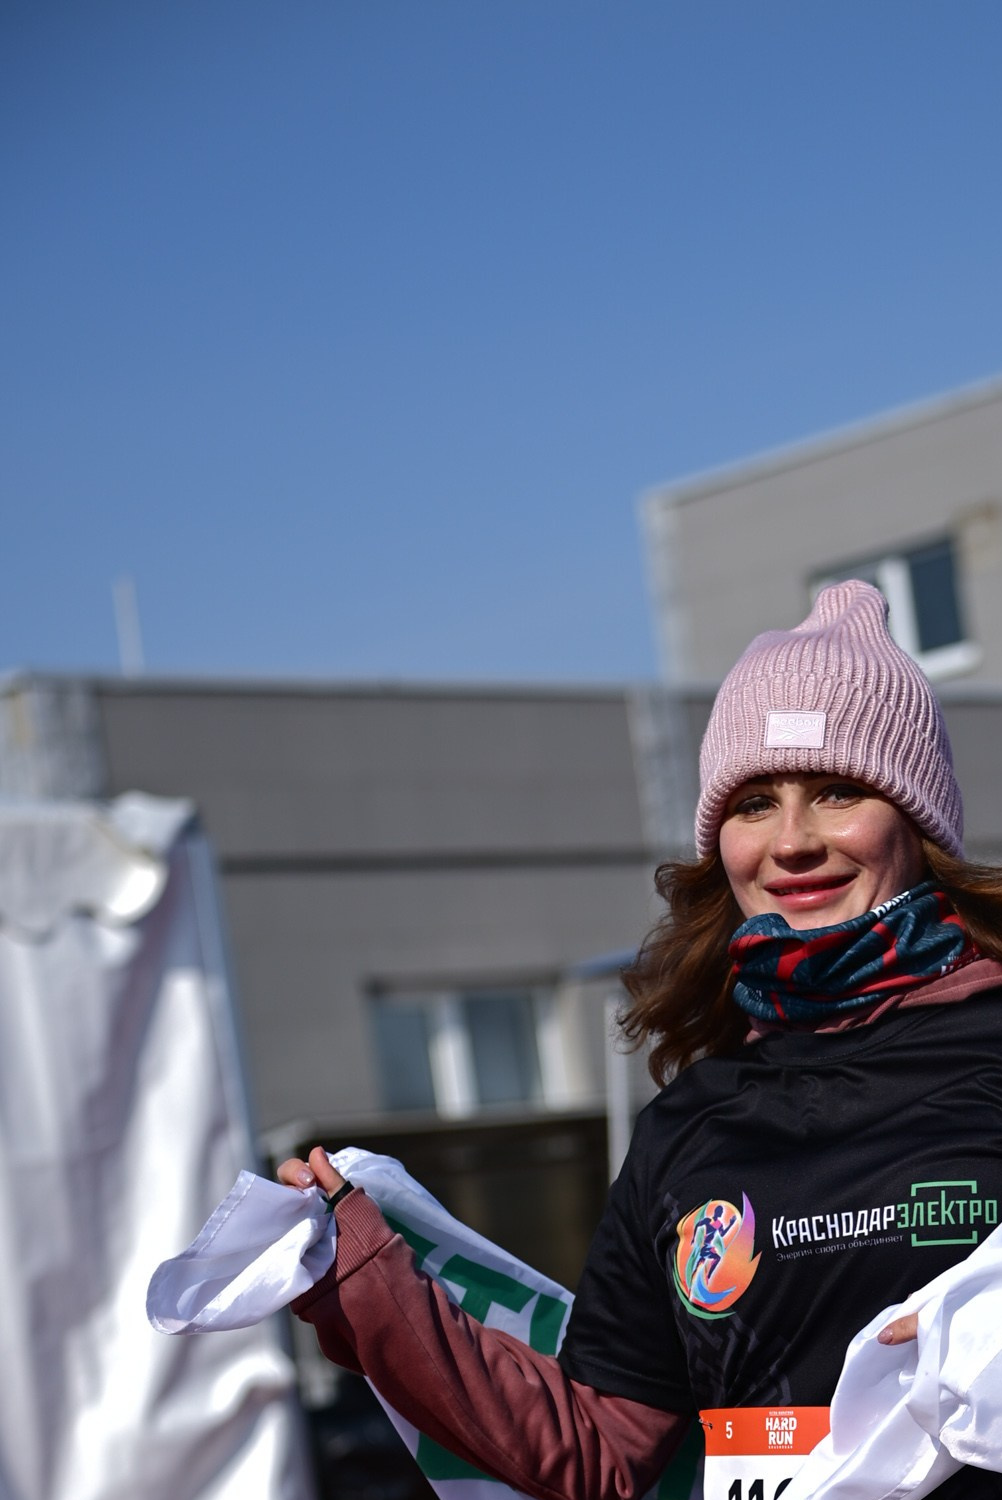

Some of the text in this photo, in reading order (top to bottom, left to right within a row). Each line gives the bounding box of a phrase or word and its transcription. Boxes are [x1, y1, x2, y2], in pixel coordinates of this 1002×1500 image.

[776, 1234, 904, 1262] Энергия спорта объединяет
[725, 1421, 733, 1439] 5
[765, 1417, 797, 1431] HARD
[768, 1431, 793, 1445] RUN
